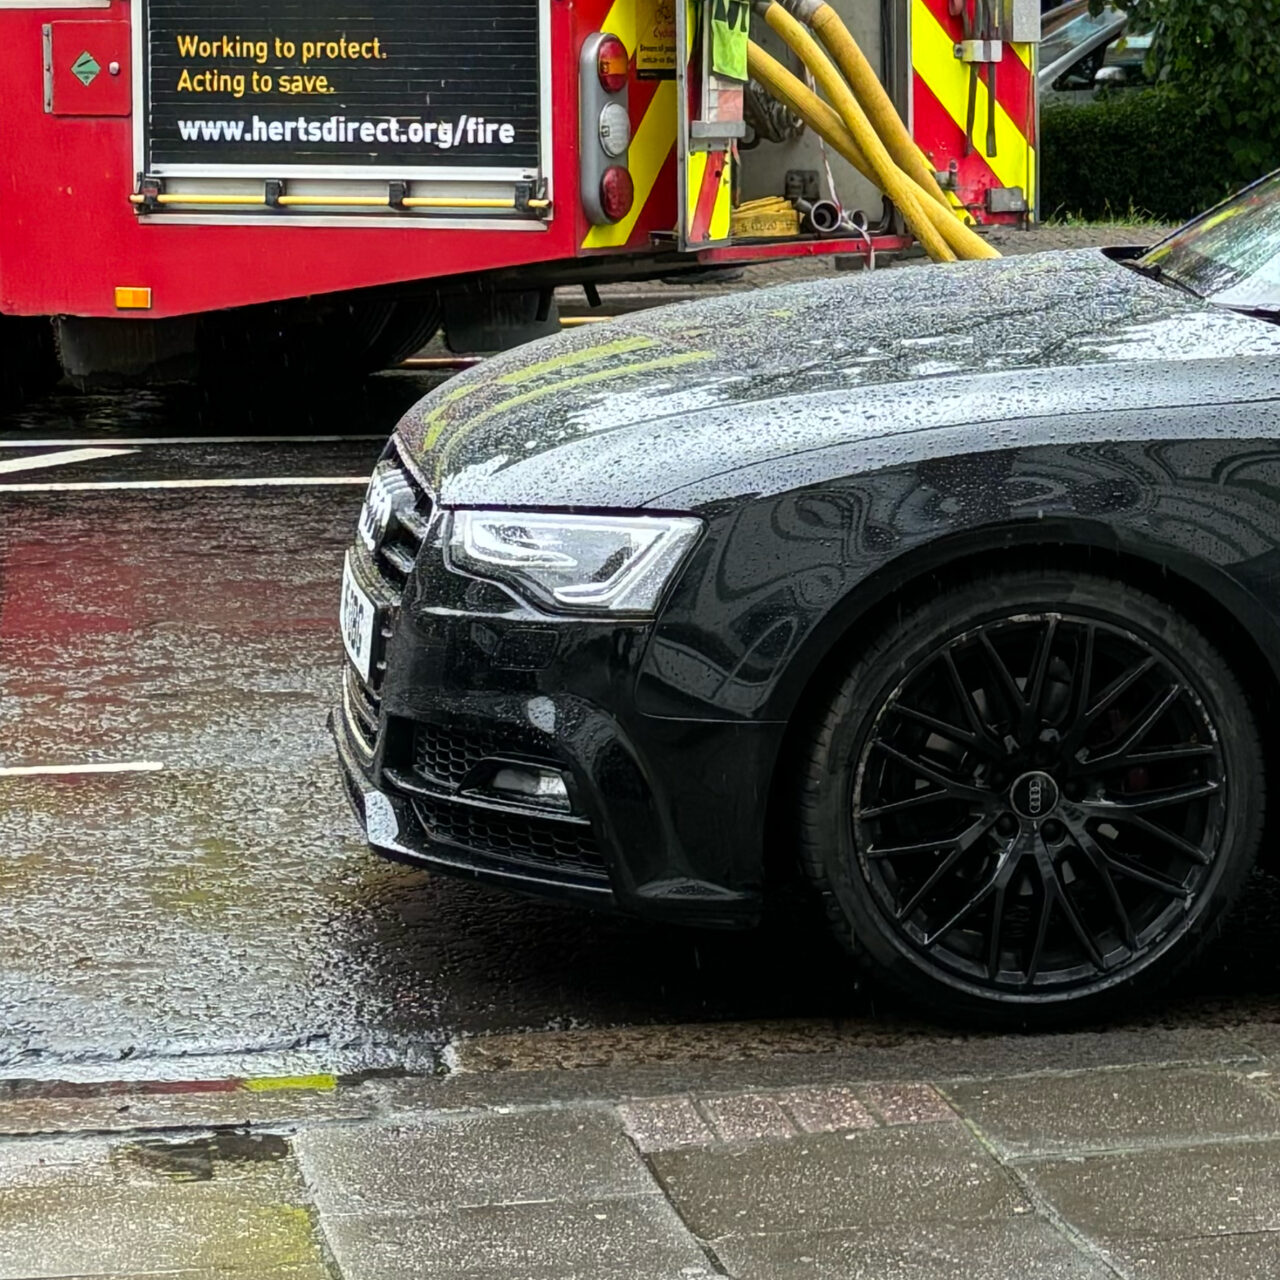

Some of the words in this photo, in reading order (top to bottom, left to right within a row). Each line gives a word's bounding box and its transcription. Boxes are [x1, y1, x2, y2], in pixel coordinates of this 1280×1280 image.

[177, 35, 268, 63] Working
[275, 37, 295, 58] to
[302, 36, 388, 63] protect.
[177, 69, 245, 97] Acting
[252, 71, 272, 92] to
[278, 74, 335, 93] save.
[178, 116, 515, 149] www.hertsdirect.org/fire
